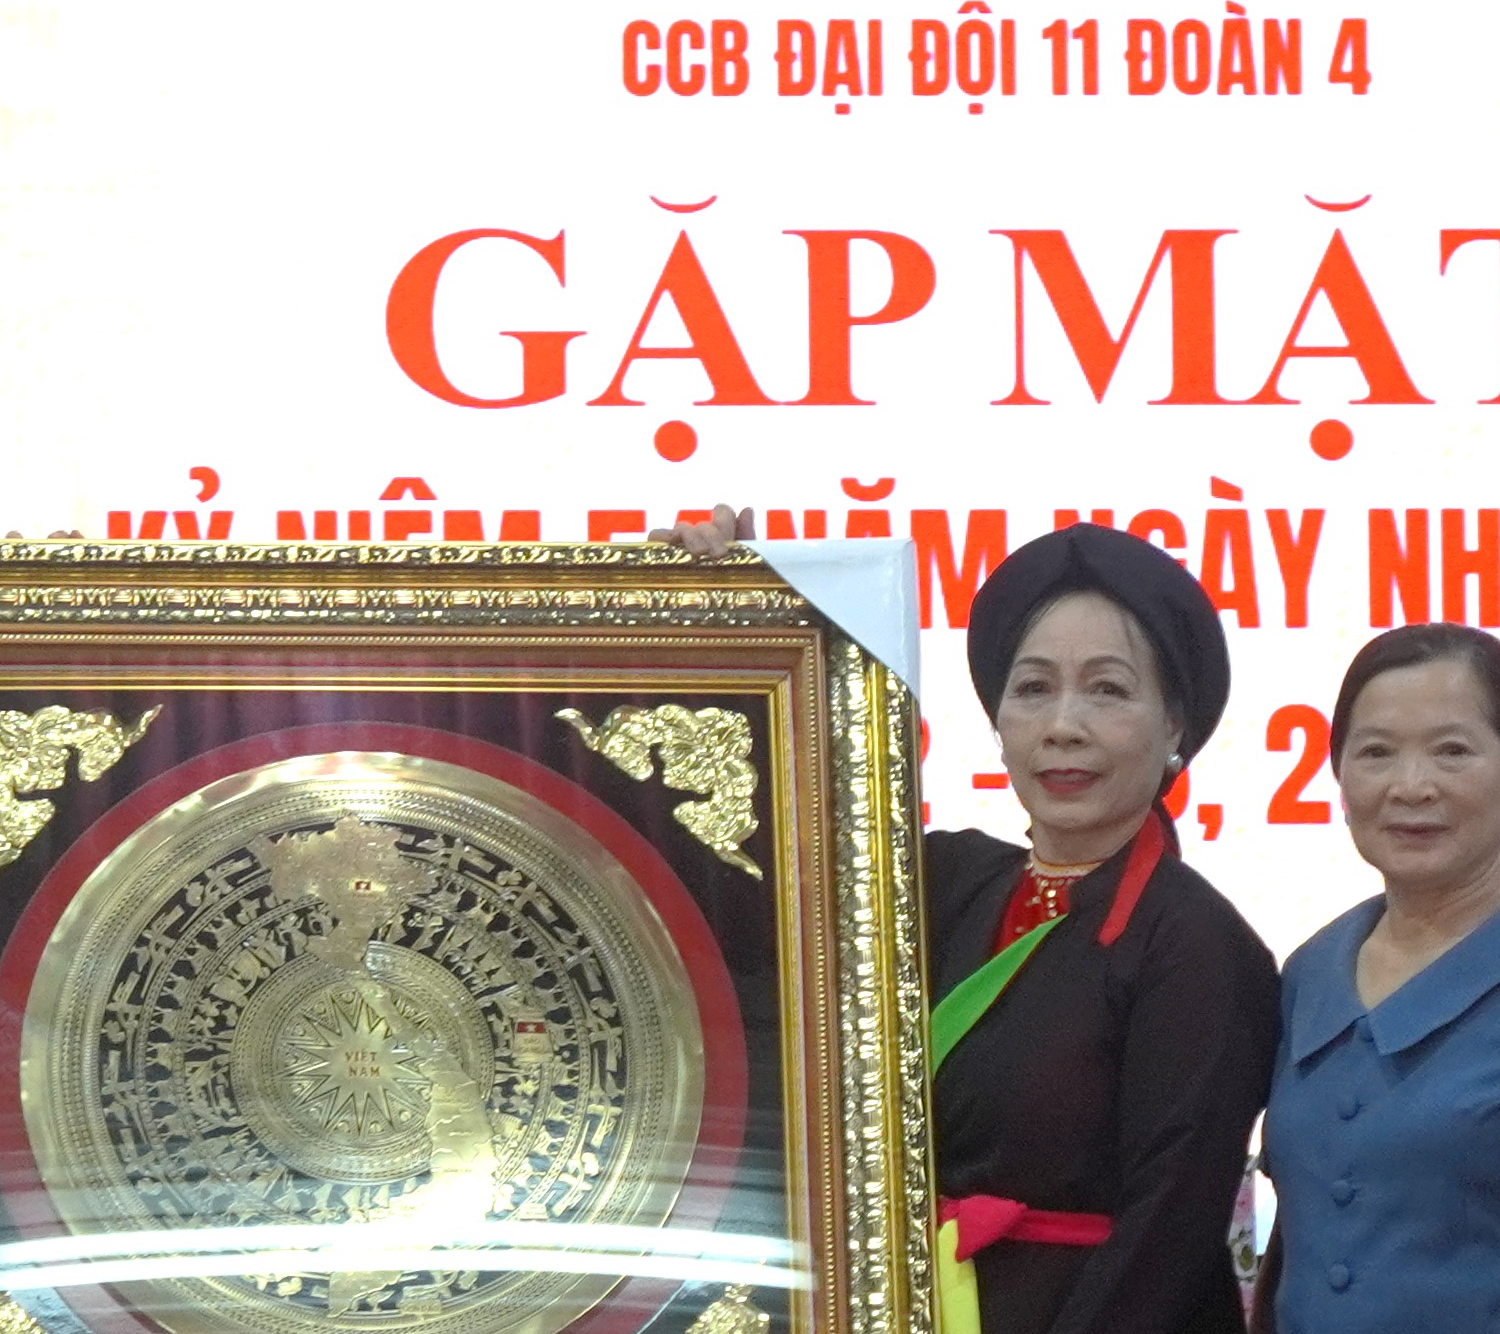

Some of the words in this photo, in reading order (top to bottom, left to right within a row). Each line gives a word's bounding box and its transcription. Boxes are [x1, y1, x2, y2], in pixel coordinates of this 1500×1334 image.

[622, 19, 749, 98] CCB
[774, 19, 883, 115] ĐẠI
[908, 0, 1016, 115] ĐỘI
[1042, 19, 1099, 96] 11
[1124, 0, 1303, 96] ĐOÀN
[1328, 18, 1372, 95] 4
[384, 196, 937, 463] GẶP
[1054, 476, 1326, 629] ÀY
[349, 1066, 380, 1077] NAM
